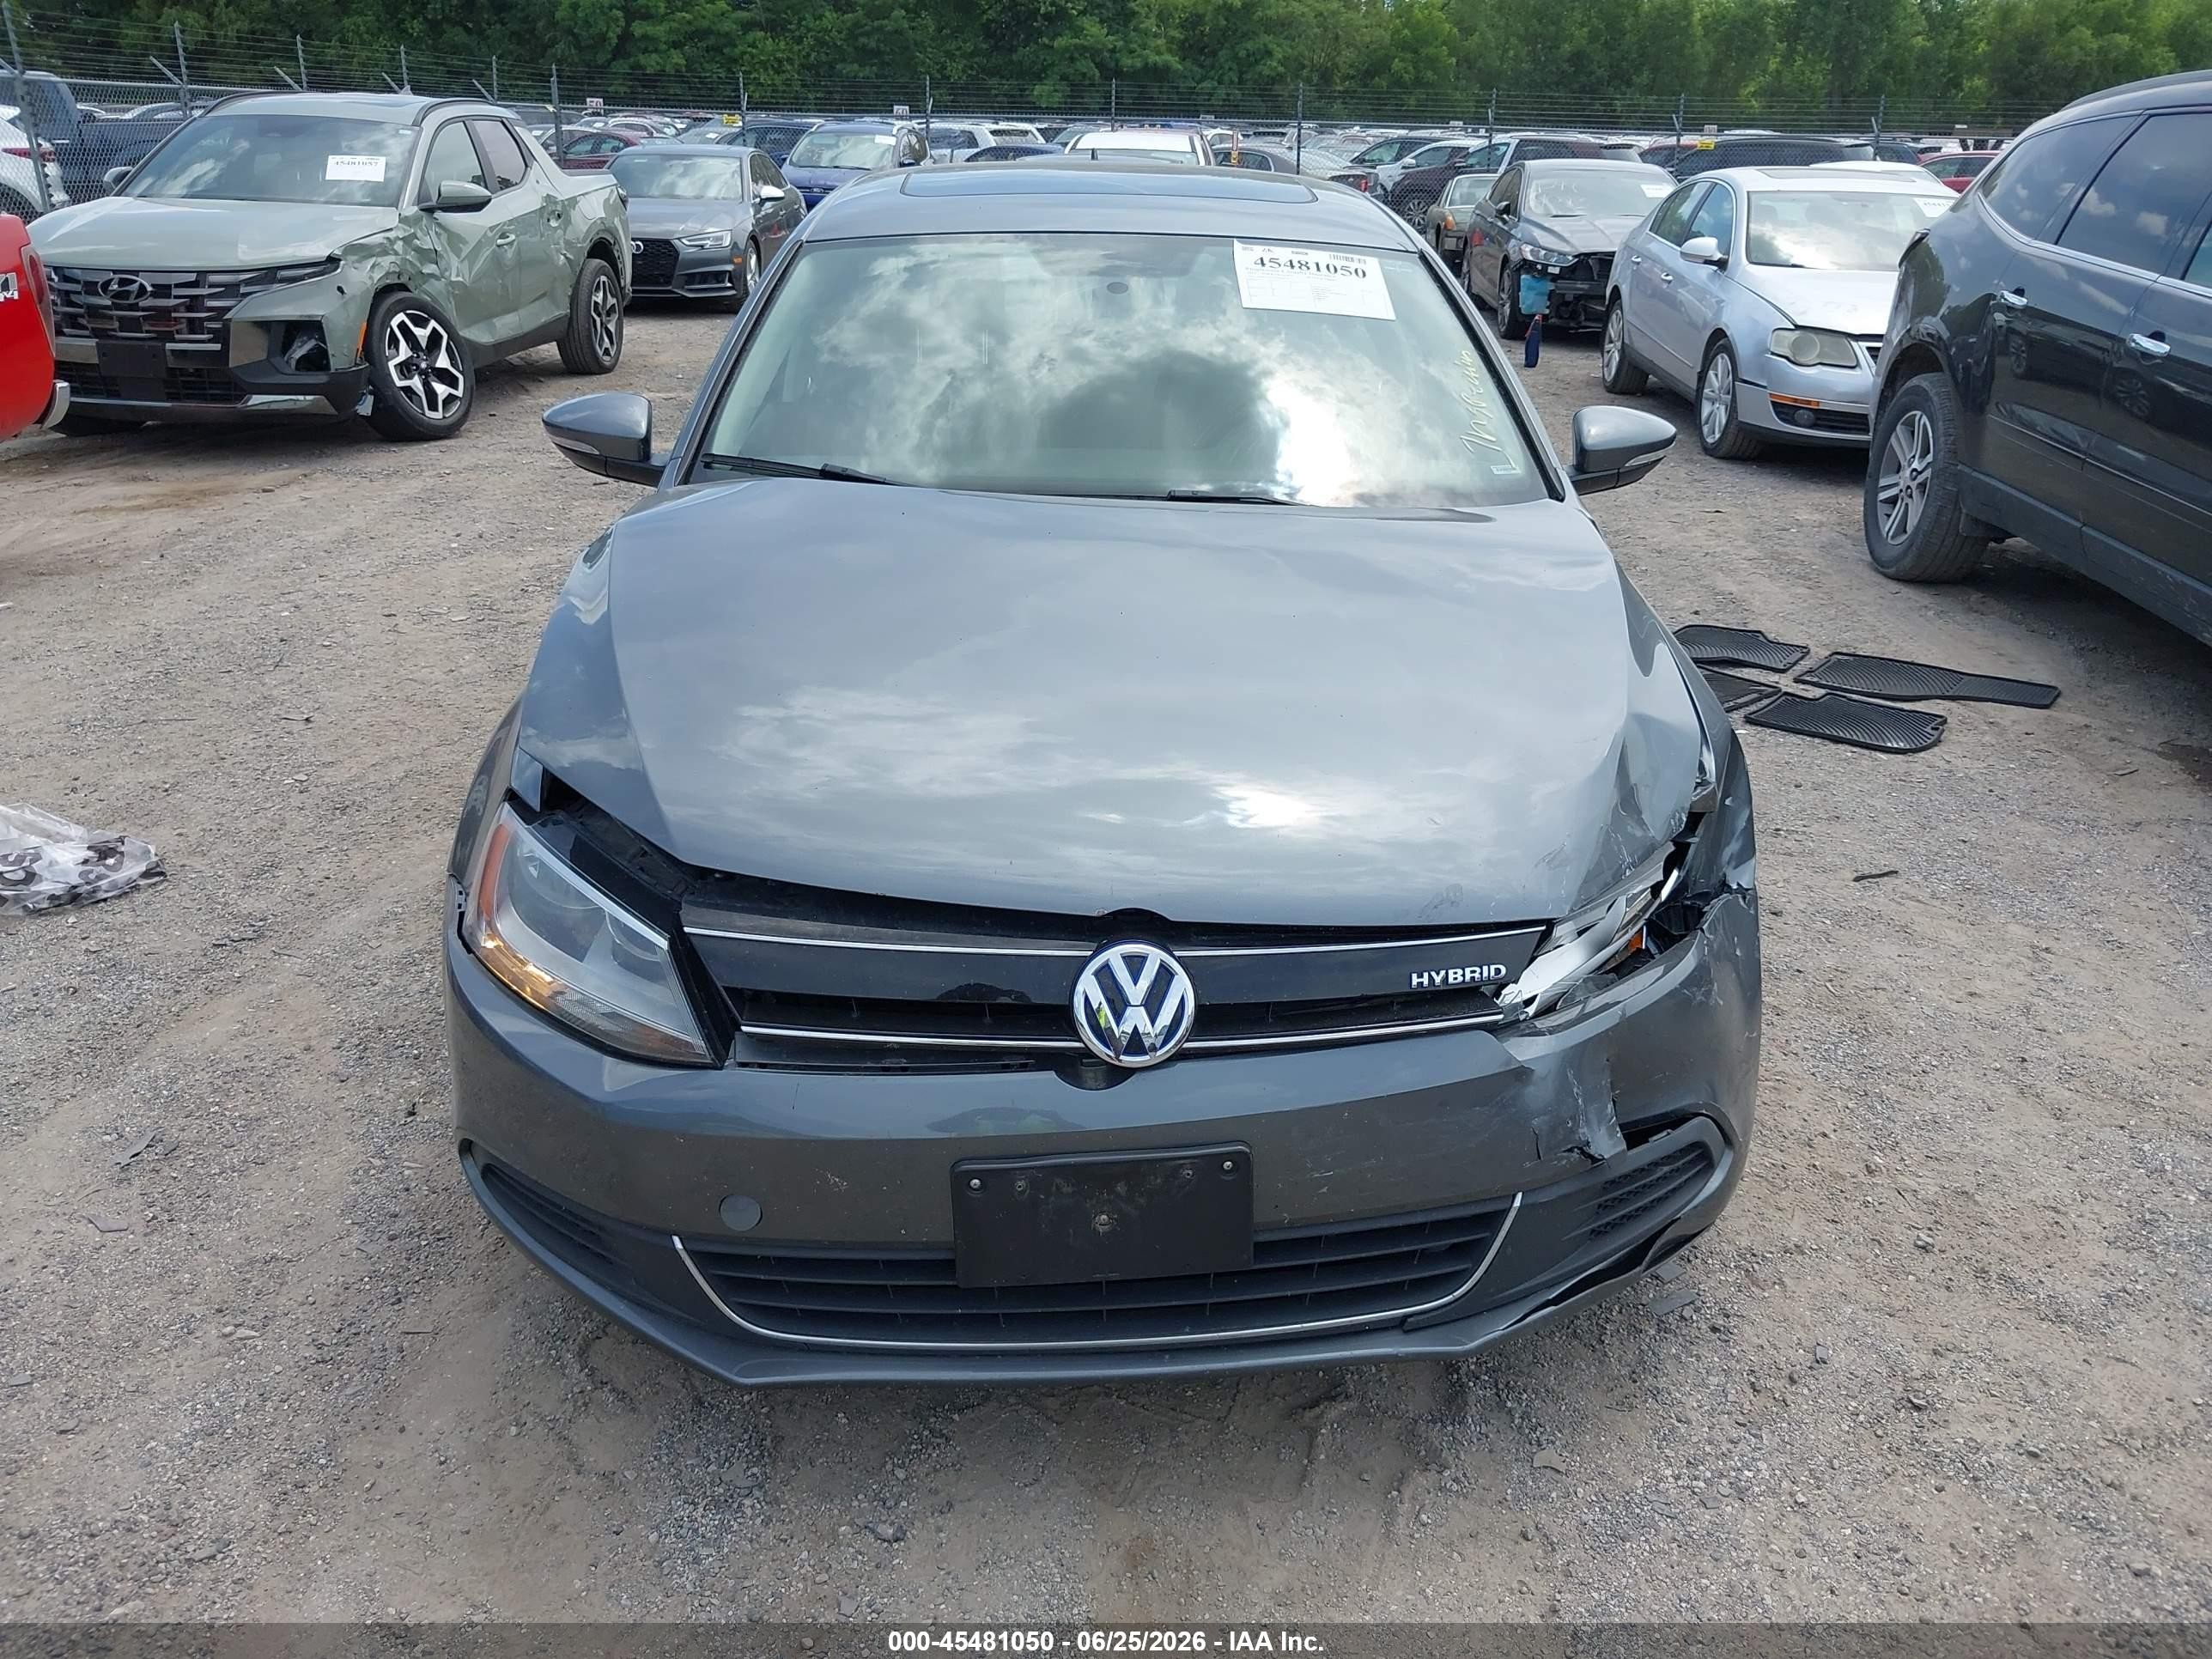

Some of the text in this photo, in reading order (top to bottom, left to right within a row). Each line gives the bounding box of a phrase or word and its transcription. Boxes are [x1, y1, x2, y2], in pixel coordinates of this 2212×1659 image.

[1254, 256, 1367, 279] 45481050
[1411, 964, 1507, 988] HYBRID
[1074, 944, 1195, 1067] VW
